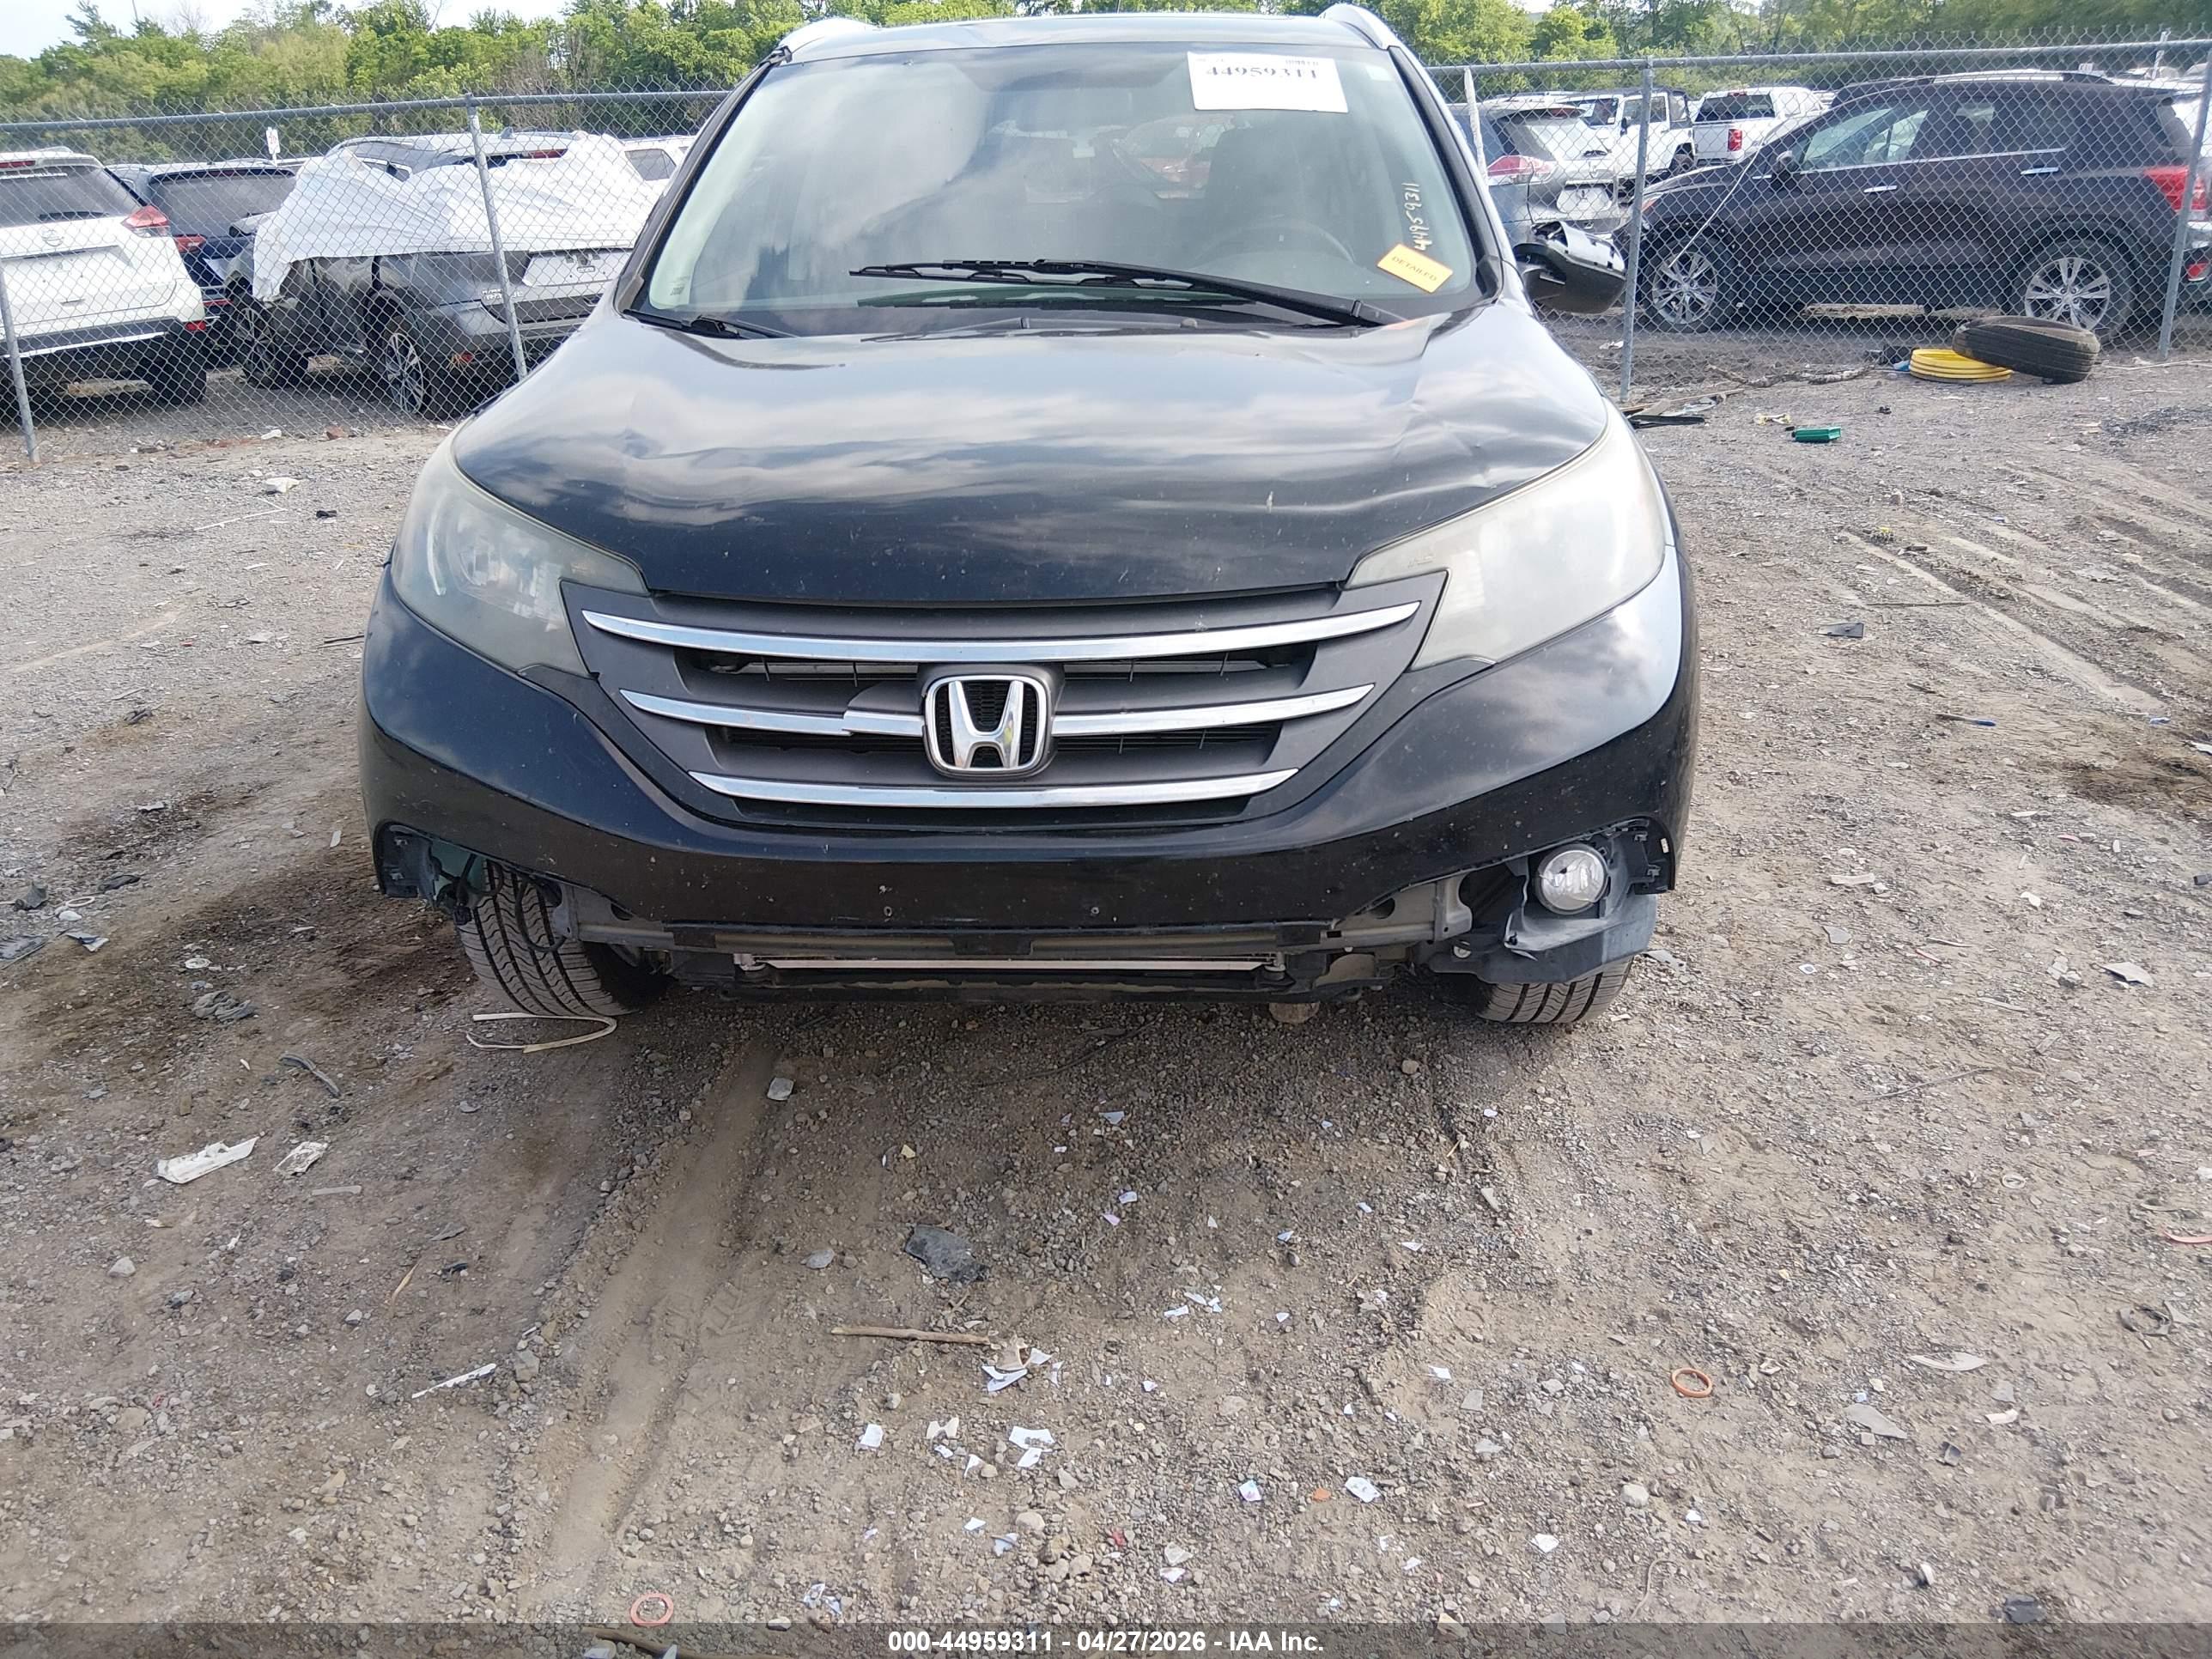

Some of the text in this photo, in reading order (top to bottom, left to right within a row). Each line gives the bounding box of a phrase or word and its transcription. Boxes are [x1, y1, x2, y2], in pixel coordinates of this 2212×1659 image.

[1206, 66, 1317, 79] 44959311
[1401, 182, 1433, 251] 44959311
[1391, 255, 1438, 282] DETAILED
